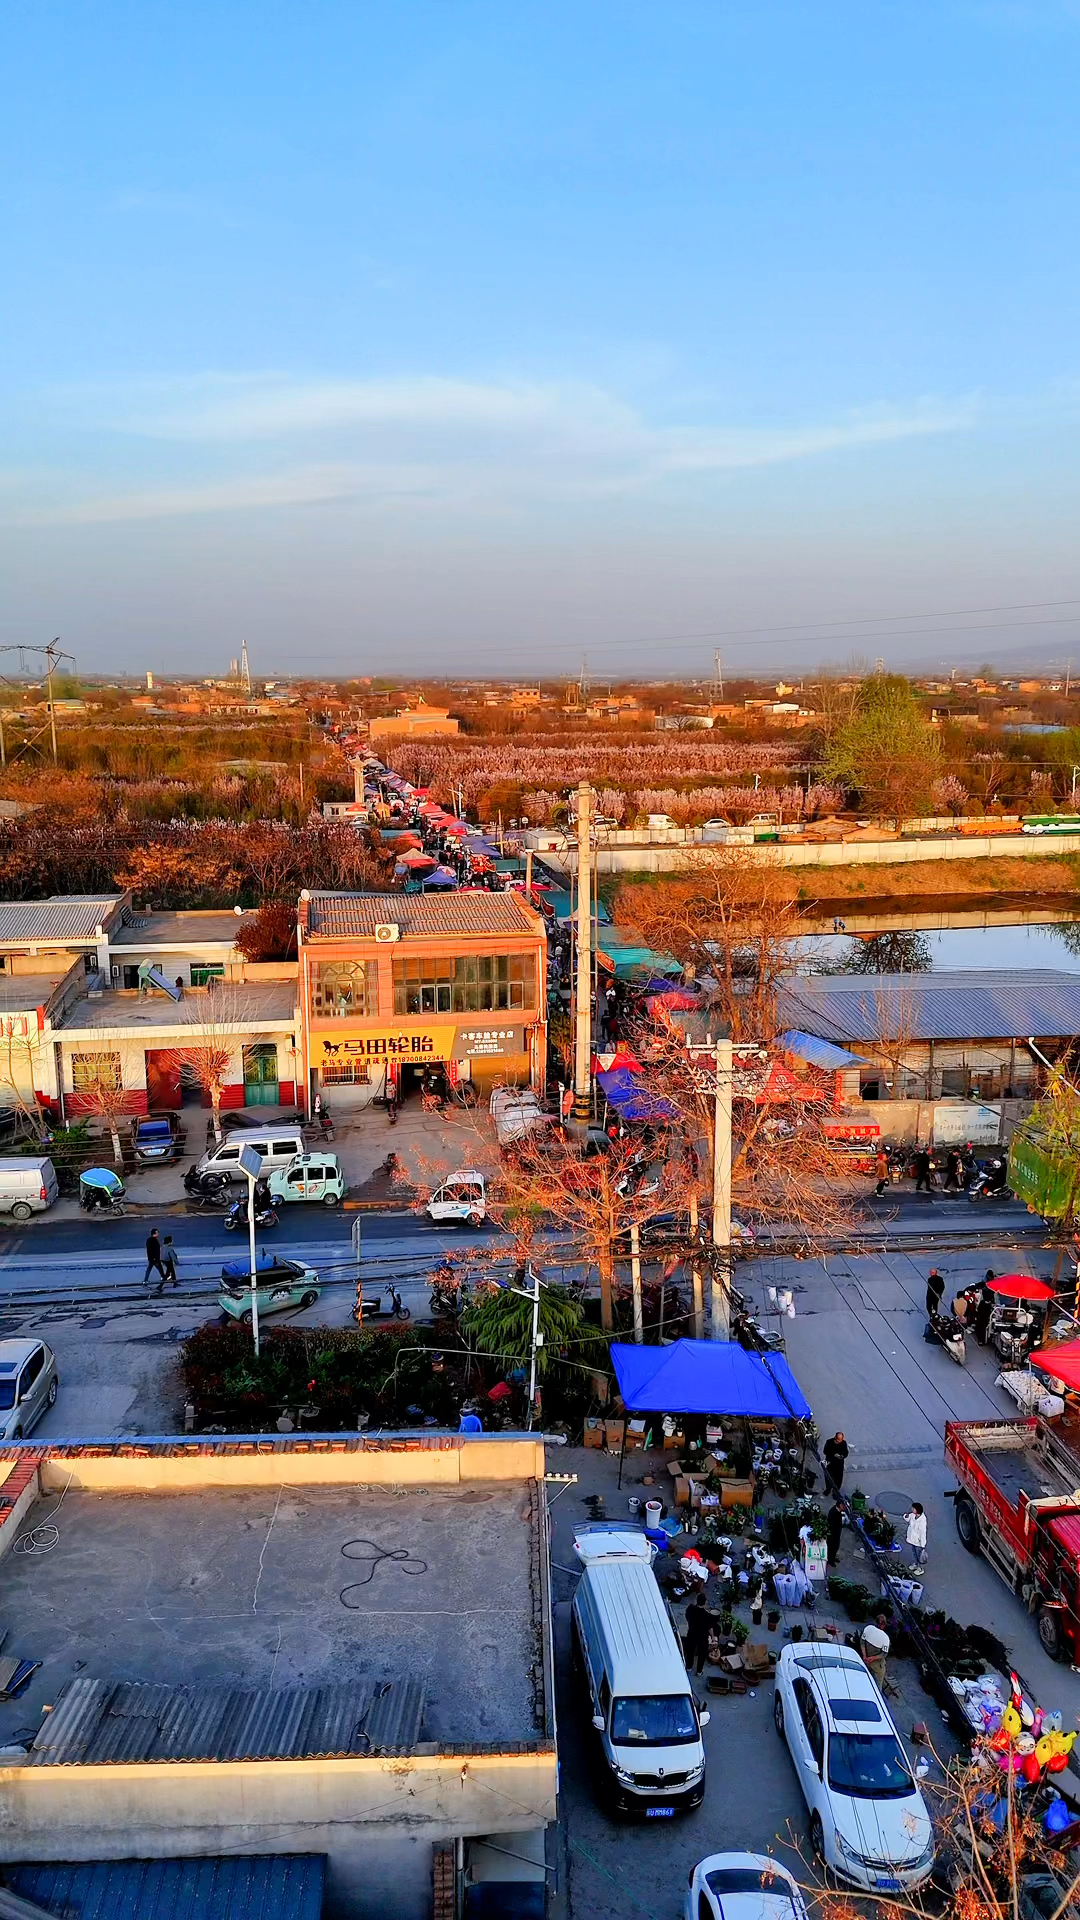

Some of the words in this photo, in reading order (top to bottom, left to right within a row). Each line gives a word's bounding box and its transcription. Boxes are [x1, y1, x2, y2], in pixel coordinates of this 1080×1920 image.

[344, 1036, 433, 1056] 马田轮胎
[398, 1055, 444, 1063] 18700842344
